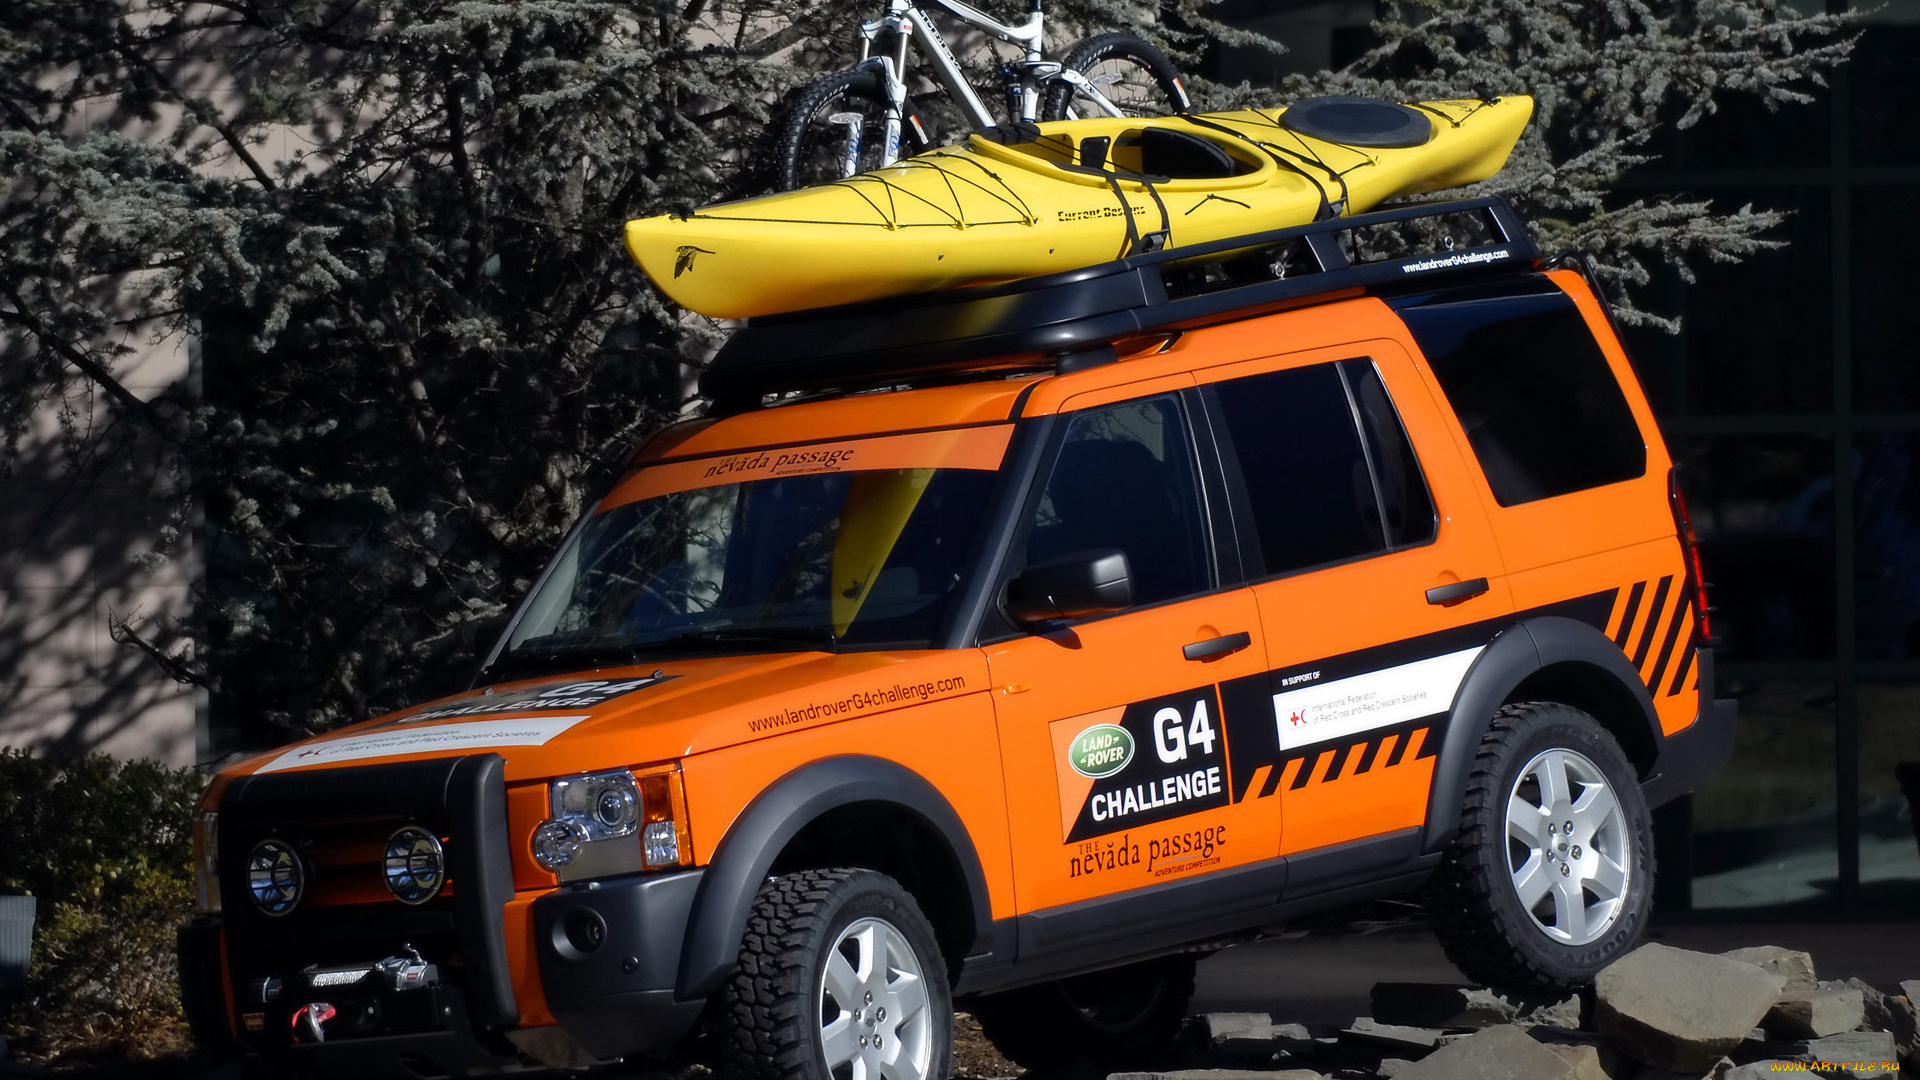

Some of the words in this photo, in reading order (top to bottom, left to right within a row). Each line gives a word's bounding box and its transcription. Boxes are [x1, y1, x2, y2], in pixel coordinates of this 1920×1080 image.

[1057, 208, 1102, 222] Current
[1103, 206, 1146, 217] Desns
[1402, 250, 1510, 274] www.landroverG4challenge.com
[770, 449, 855, 473] passage
[538, 678, 656, 698] G4
[1288, 672, 1313, 685] SUPPORT
[1312, 670, 1321, 680] OF
[398, 696, 606, 722] CHALLENGE
[748, 676, 966, 733] www.landroverG4challenge.com
[1311, 698, 1346, 713] International
[1347, 691, 1378, 704] Federation
[1362, 703, 1375, 712] Red
[1375, 698, 1401, 710] Crescent
[1401, 691, 1428, 704] Societies
[1153, 699, 1216, 764] G4
[1082, 733, 1112, 754] LAND
[1086, 746, 1124, 768] ROVER
[1091, 766, 1222, 822] CHALLENGE
[1078, 840, 1100, 855] THE
[1147, 825, 1226, 873] passage
[1154, 864, 1185, 877] ADVENTURE
[1185, 856, 1221, 870] COMPETITION
